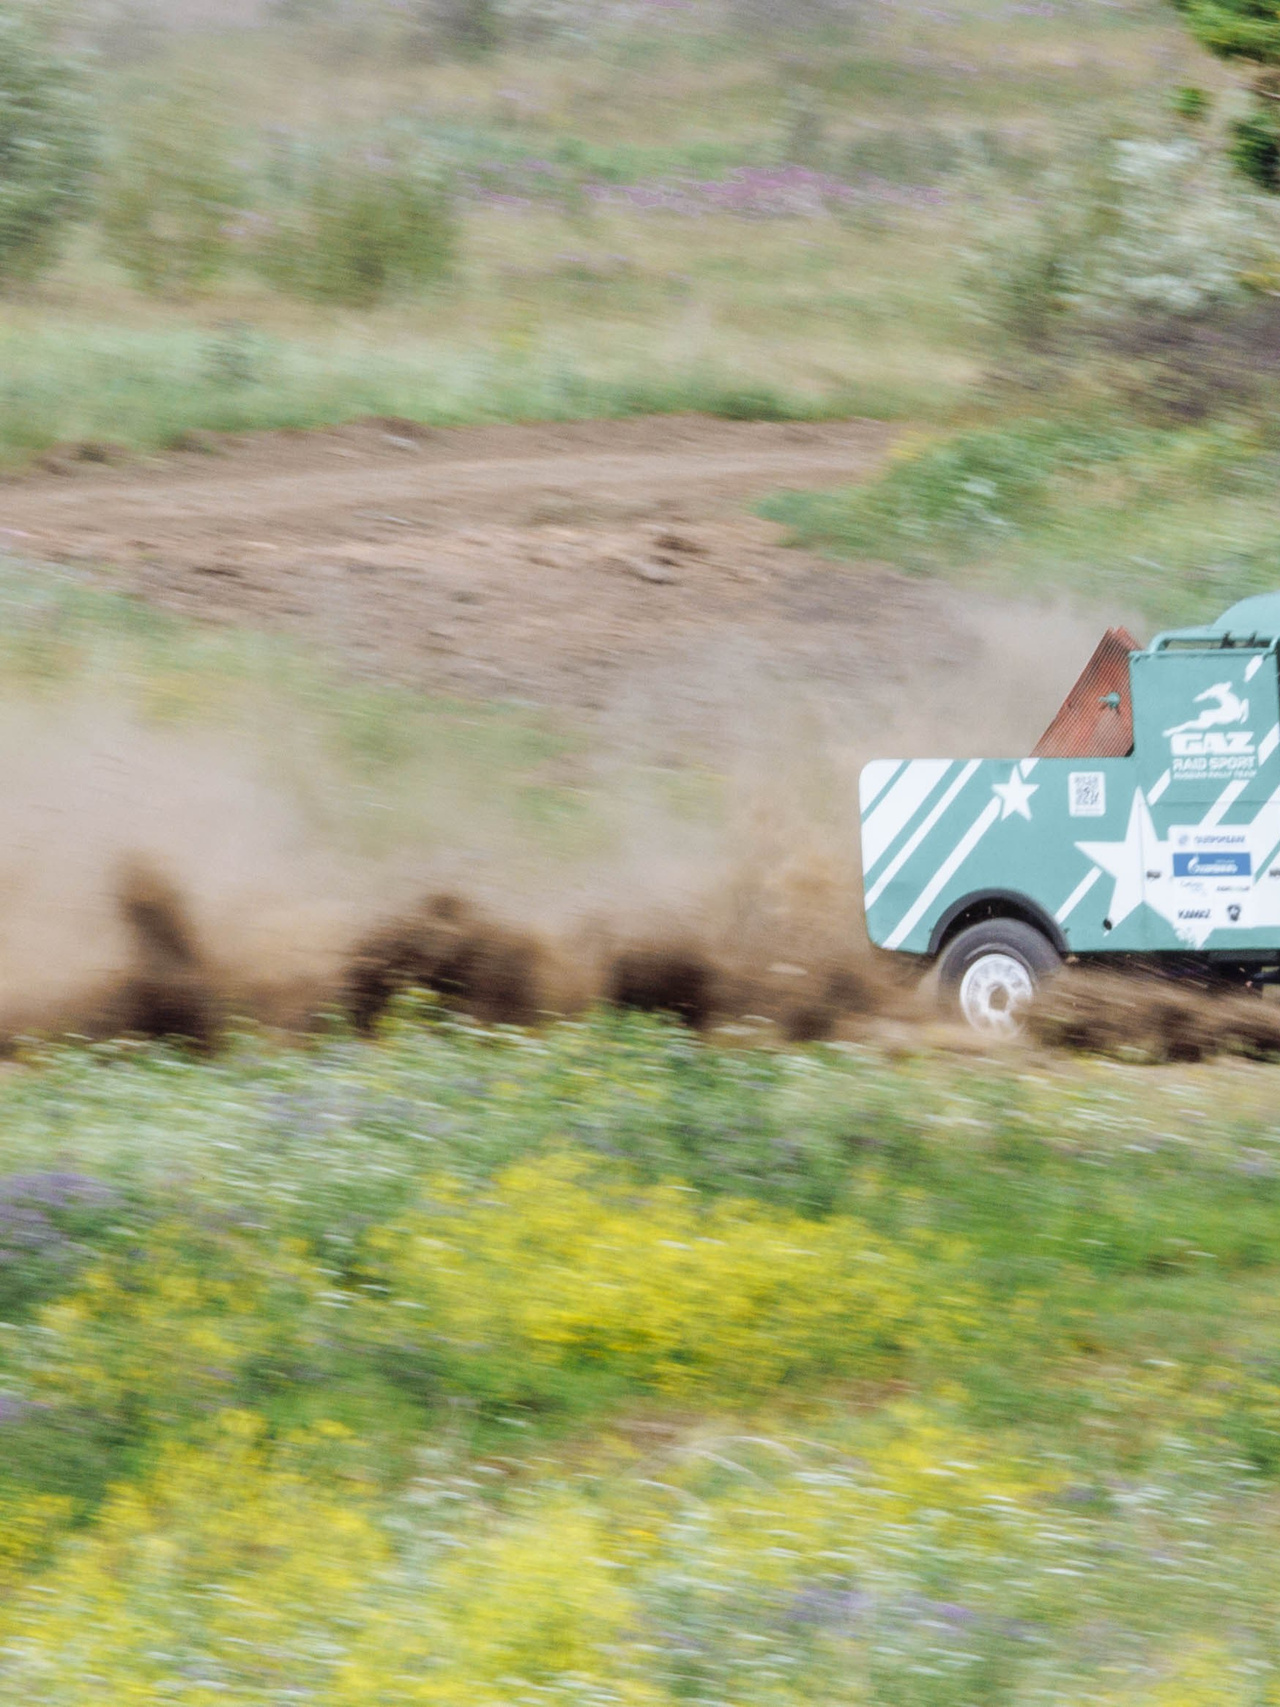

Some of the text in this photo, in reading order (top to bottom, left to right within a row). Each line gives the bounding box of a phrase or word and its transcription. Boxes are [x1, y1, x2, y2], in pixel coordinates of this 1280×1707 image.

[1171, 731, 1255, 756] GAZ
[1173, 756, 1255, 771] RAID SPORT
